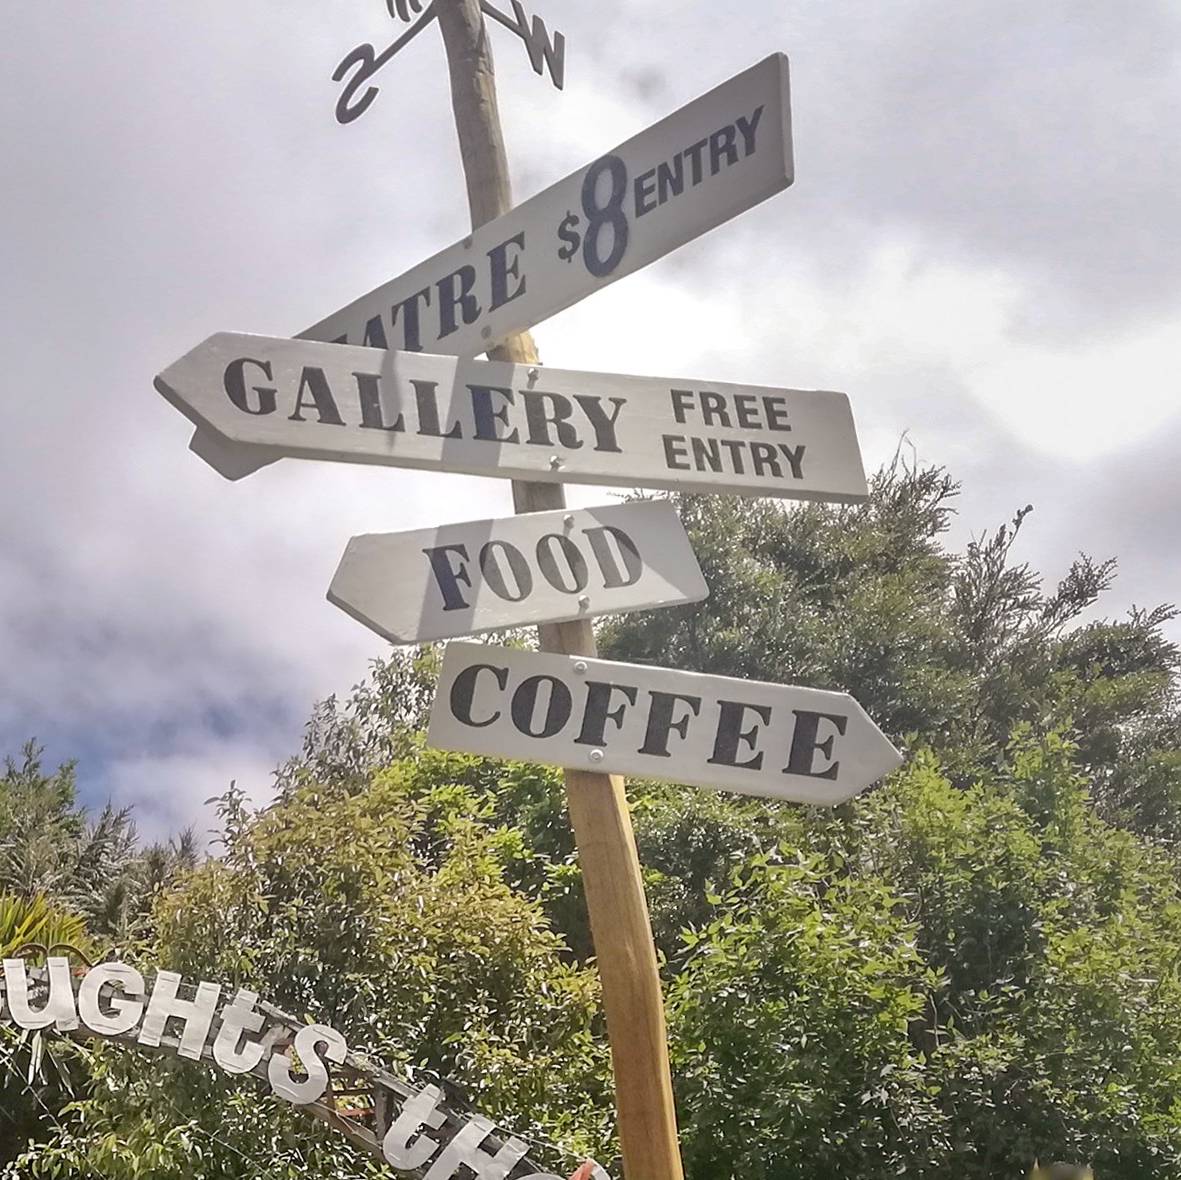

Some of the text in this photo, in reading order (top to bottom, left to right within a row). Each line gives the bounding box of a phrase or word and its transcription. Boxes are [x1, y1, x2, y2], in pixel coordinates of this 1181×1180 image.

[331, 105, 764, 353] ATRE $8 ENTRY
[223, 357, 626, 453] GALLERY
[671, 388, 793, 432] FREE
[662, 434, 806, 480] ENTRY
[422, 526, 643, 611] FOOD
[450, 664, 848, 780] COFFEE
